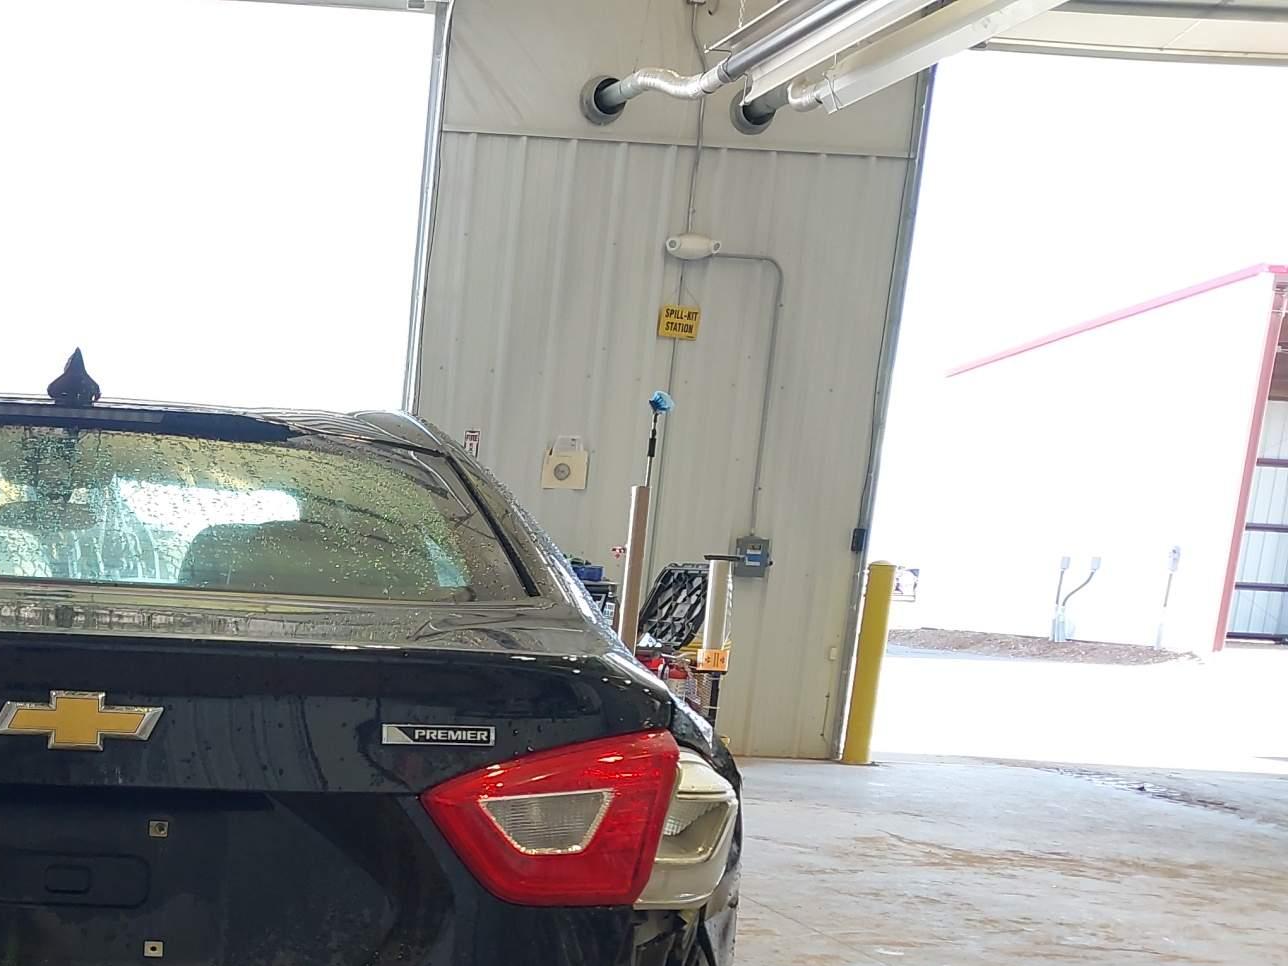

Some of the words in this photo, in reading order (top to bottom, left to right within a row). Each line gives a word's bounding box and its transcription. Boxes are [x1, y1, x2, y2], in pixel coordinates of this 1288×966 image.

[665, 308, 699, 321] SPILL-KIT
[665, 321, 694, 333] STATION
[414, 729, 488, 741] PREMIER
